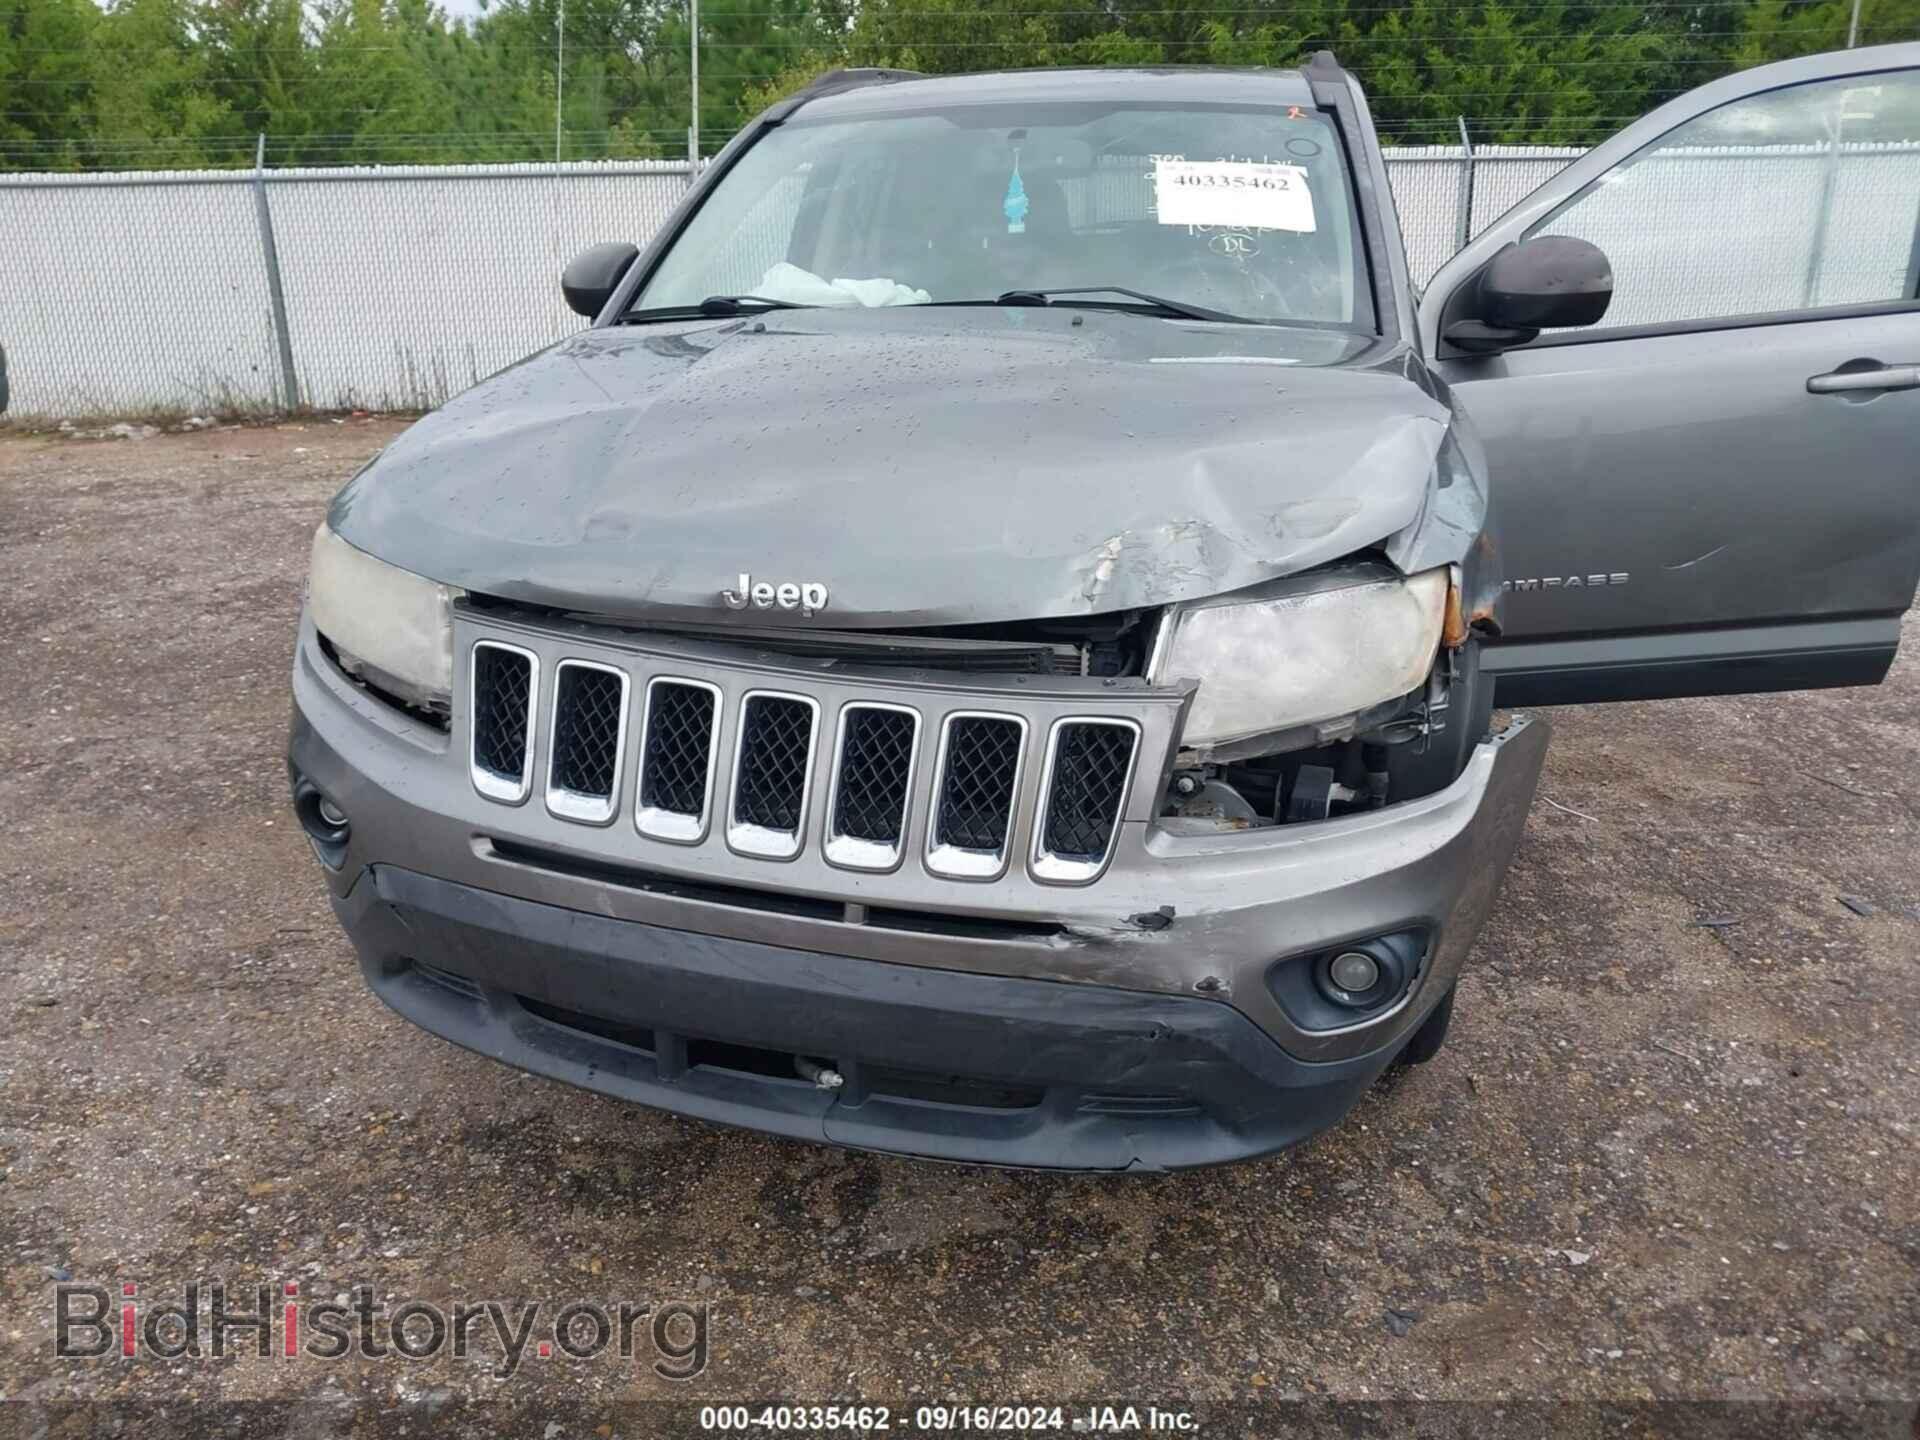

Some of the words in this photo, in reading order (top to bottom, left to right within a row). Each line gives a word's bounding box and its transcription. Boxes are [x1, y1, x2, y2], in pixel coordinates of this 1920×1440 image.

[1174, 174, 1290, 191] 40335462
[1503, 572, 1629, 592] MPASS
[722, 573, 828, 618] Jeep
